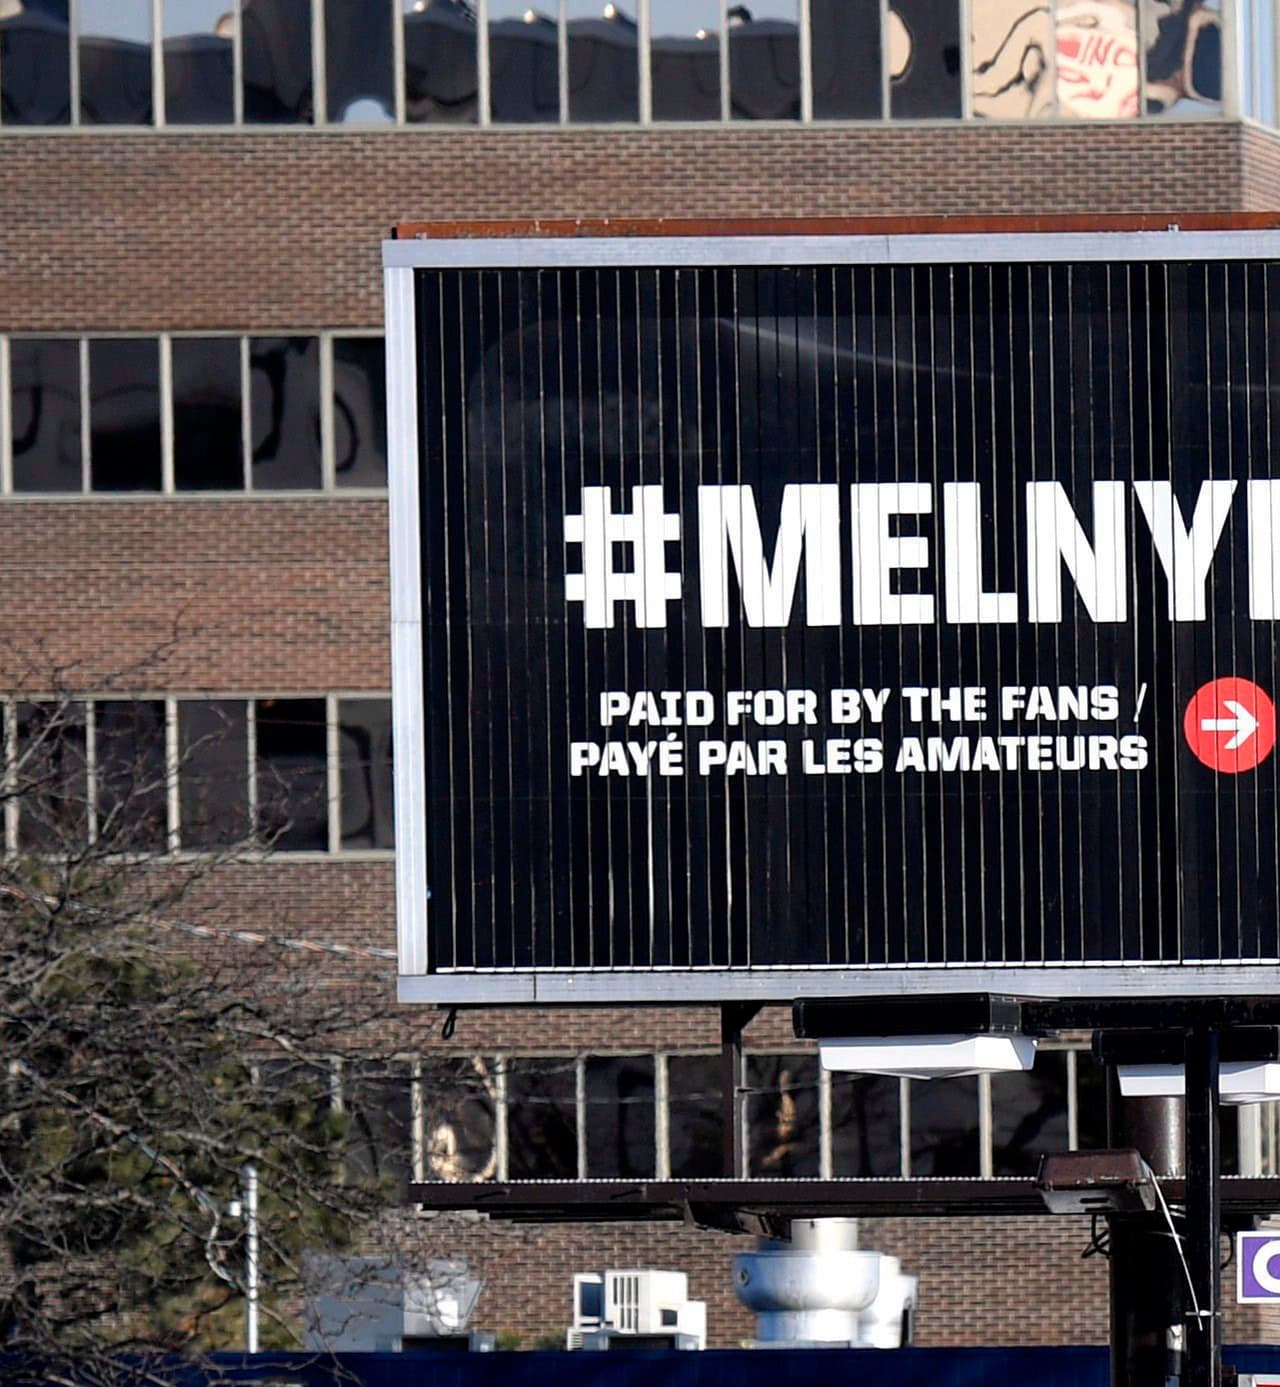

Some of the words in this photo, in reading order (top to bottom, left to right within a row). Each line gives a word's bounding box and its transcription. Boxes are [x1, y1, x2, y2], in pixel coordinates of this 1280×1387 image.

[600, 690, 714, 726] PAID
[727, 689, 818, 725] FOR
[831, 688, 890, 723] BY
[902, 687, 988, 722] THE
[1001, 685, 1119, 721] FANS
[1132, 682, 1148, 722] /
[570, 732, 684, 776] PAYÉ
[699, 739, 788, 775] PAR
[803, 738, 883, 774] LES
[895, 734, 1149, 773] AMATEURS
